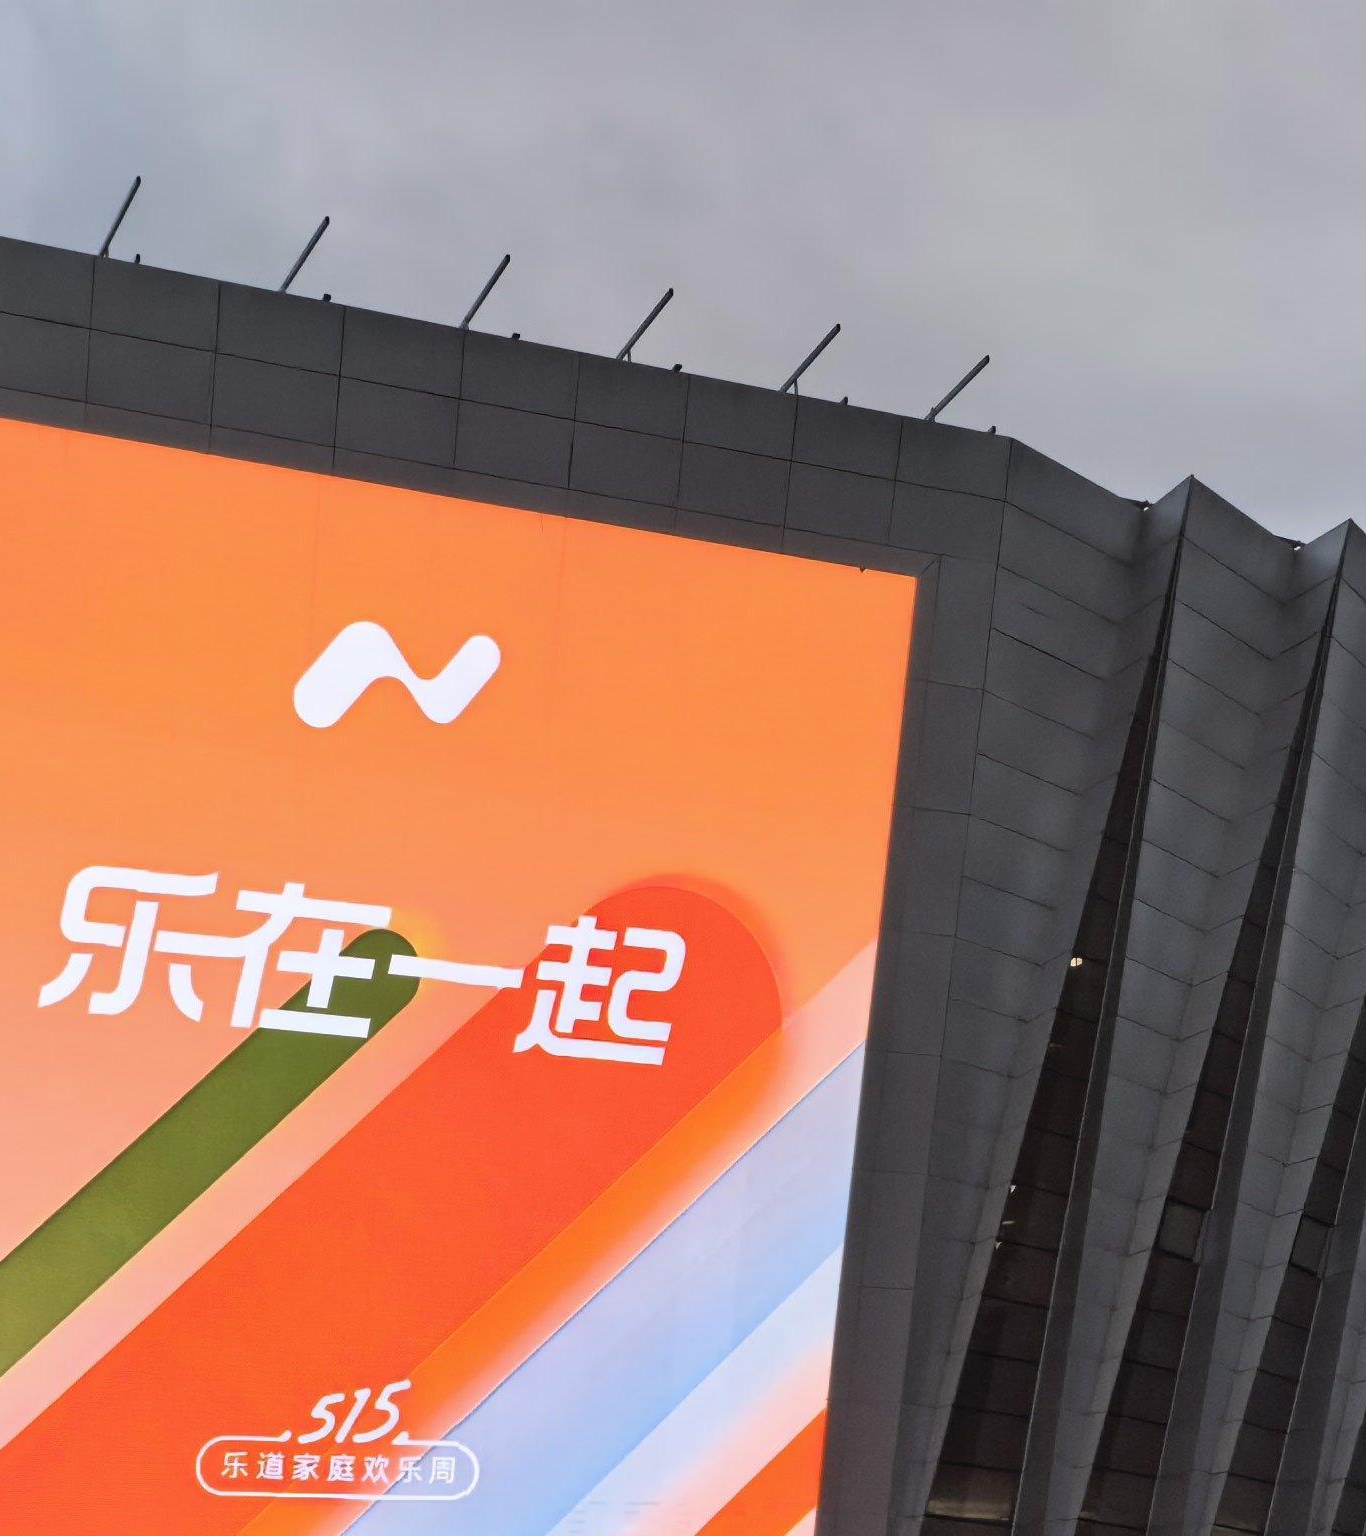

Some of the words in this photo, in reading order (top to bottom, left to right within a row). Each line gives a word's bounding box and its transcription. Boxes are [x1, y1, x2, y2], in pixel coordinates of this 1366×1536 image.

[38, 866, 686, 1067] 乐在一起
[297, 1379, 413, 1445] 515
[219, 1449, 457, 1486] 乐道家庭欢乐周
